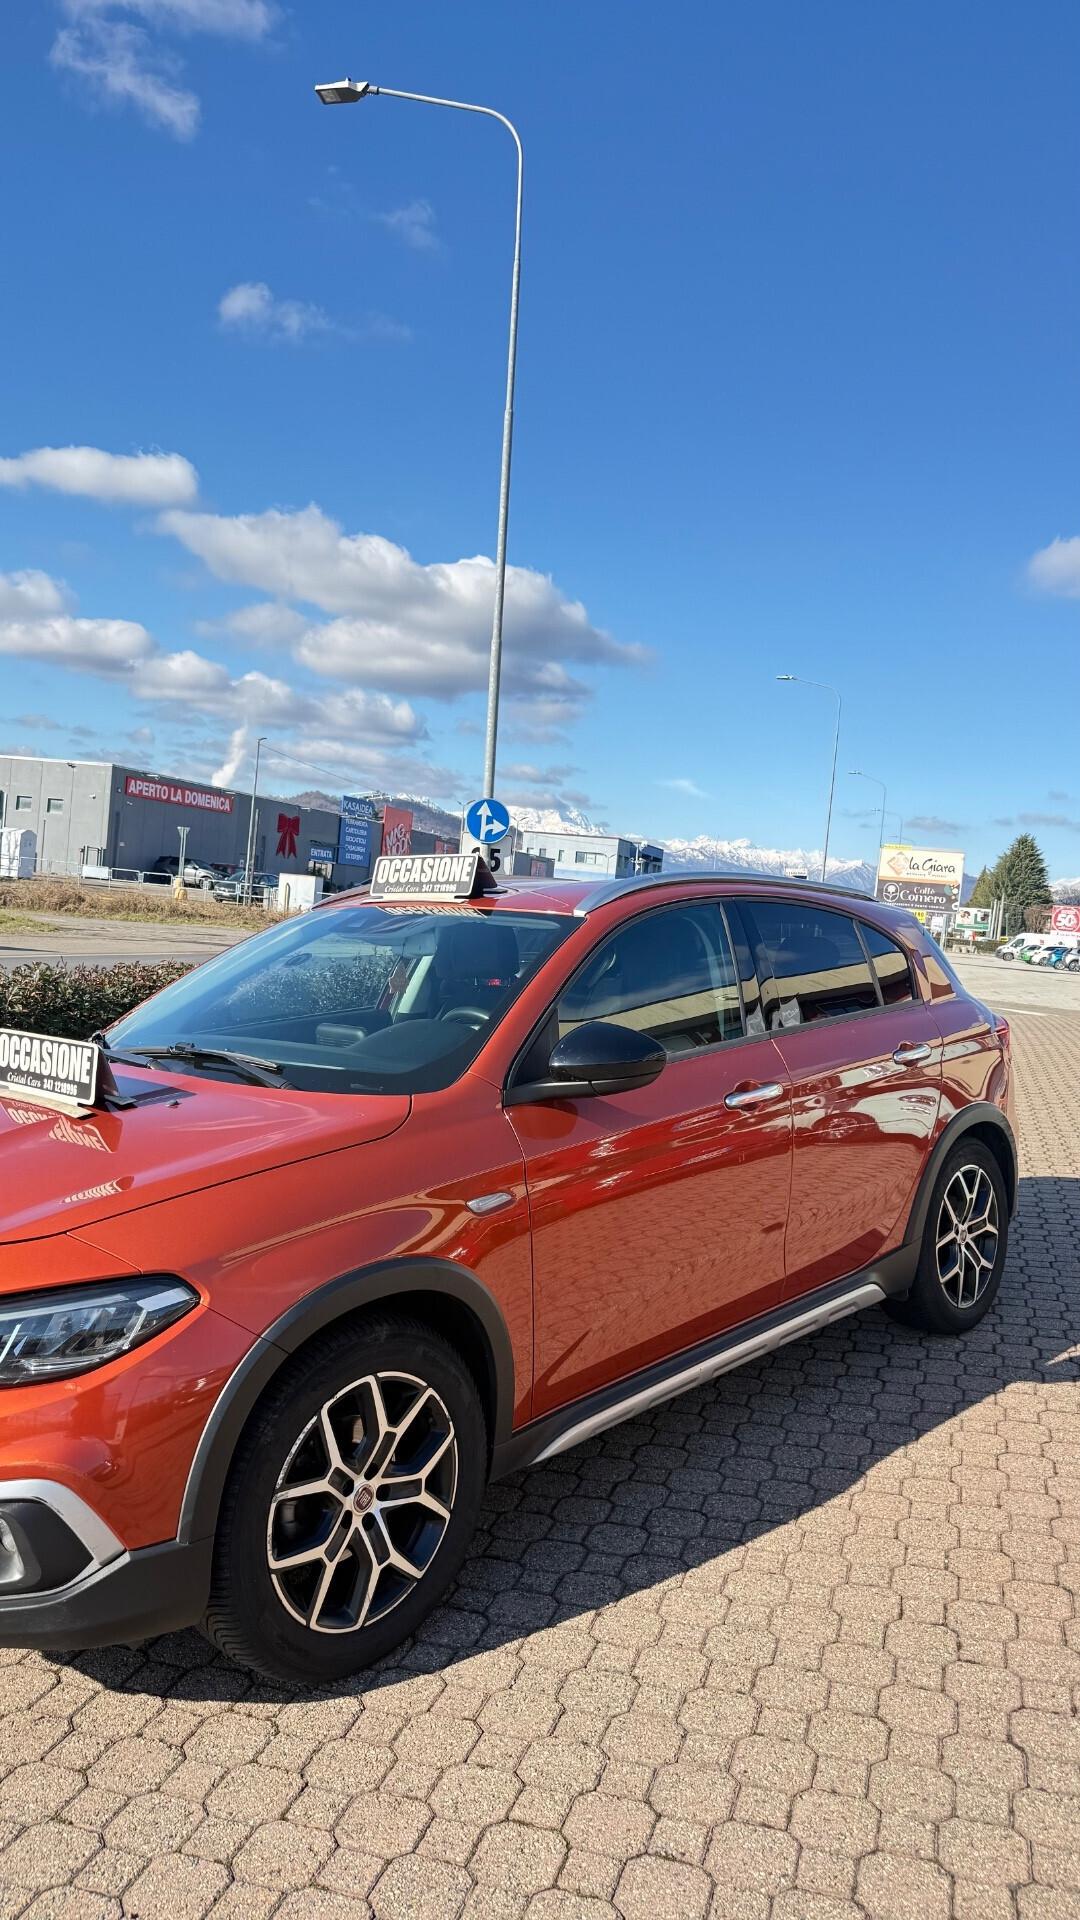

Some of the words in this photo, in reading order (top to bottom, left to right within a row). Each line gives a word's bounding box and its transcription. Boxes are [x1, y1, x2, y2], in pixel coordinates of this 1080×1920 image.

[128, 779, 169, 800] APERTO
[170, 786, 183, 803] LA
[185, 789, 231, 812] DOMENICA
[376, 857, 473, 883] OCCASIONE
[922, 858, 956, 875] Giara
[422, 884, 432, 892] 347
[899, 889, 946, 904] Comero
[0, 1034, 92, 1084] OCCASIONE
[28, 1075, 42, 1088] Cars
[43, 1078, 54, 1092] 347
